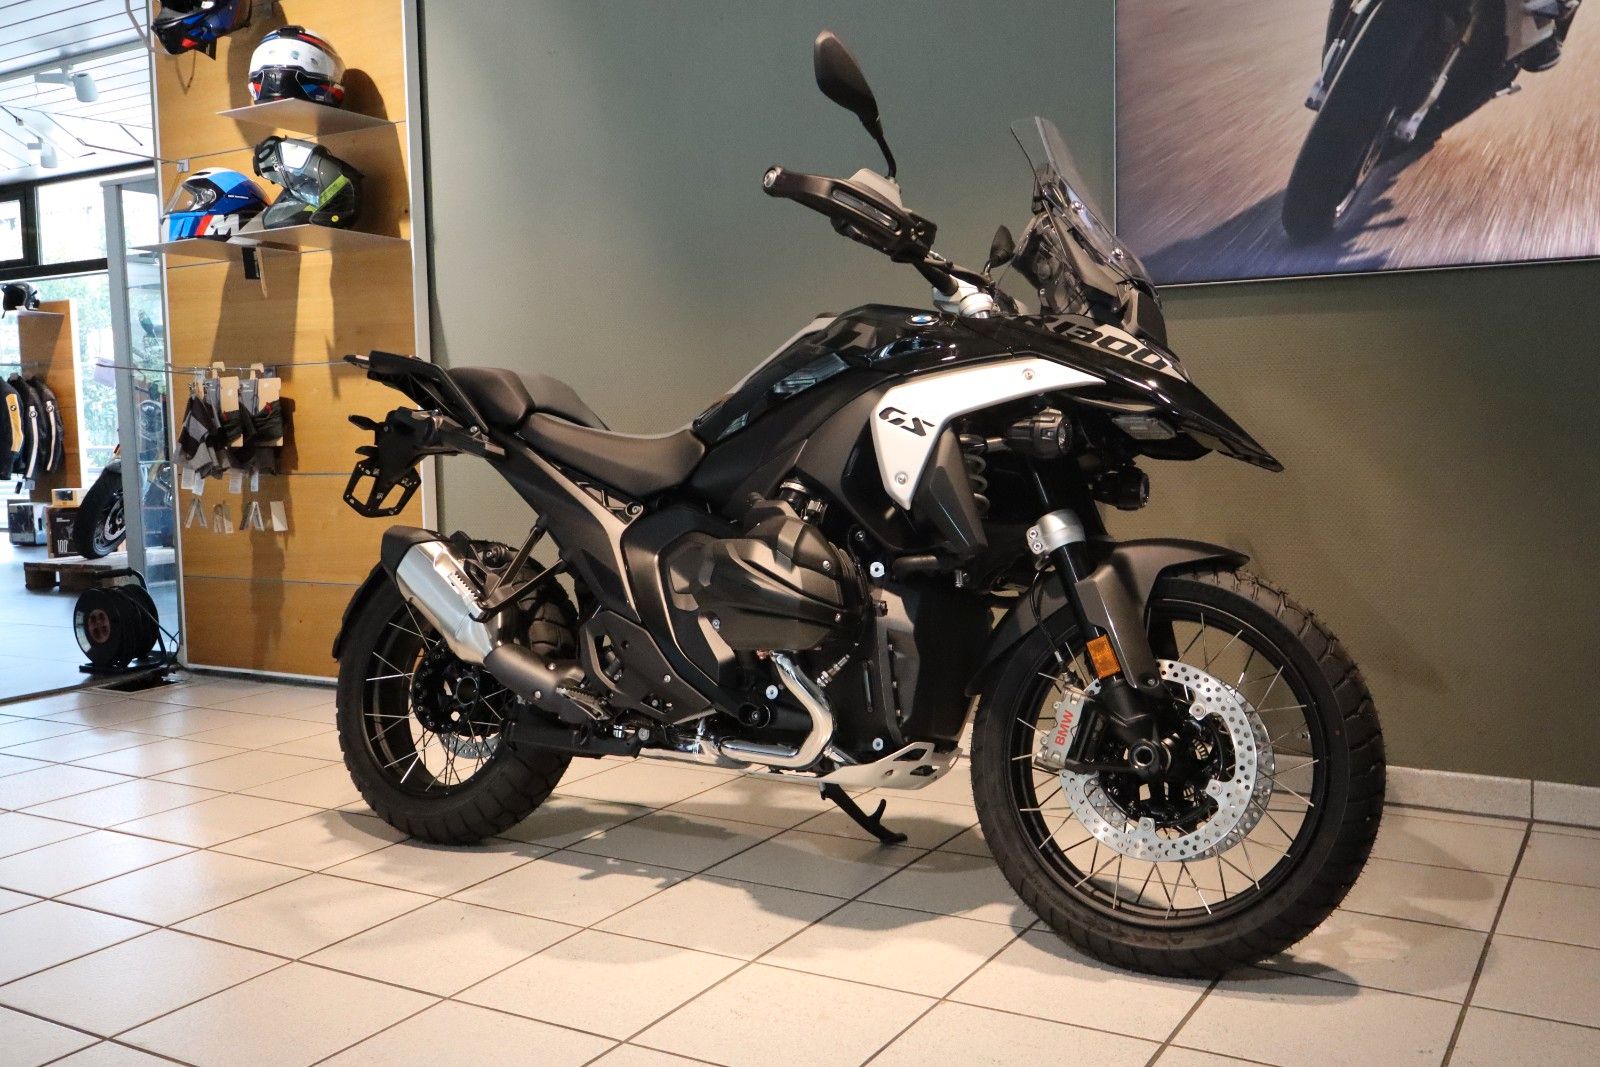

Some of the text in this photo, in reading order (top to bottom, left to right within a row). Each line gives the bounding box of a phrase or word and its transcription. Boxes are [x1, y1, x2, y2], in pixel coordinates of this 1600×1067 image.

[1053, 321, 1170, 371] 1300
[878, 406, 935, 437] GS
[1055, 709, 1073, 746] BMW
